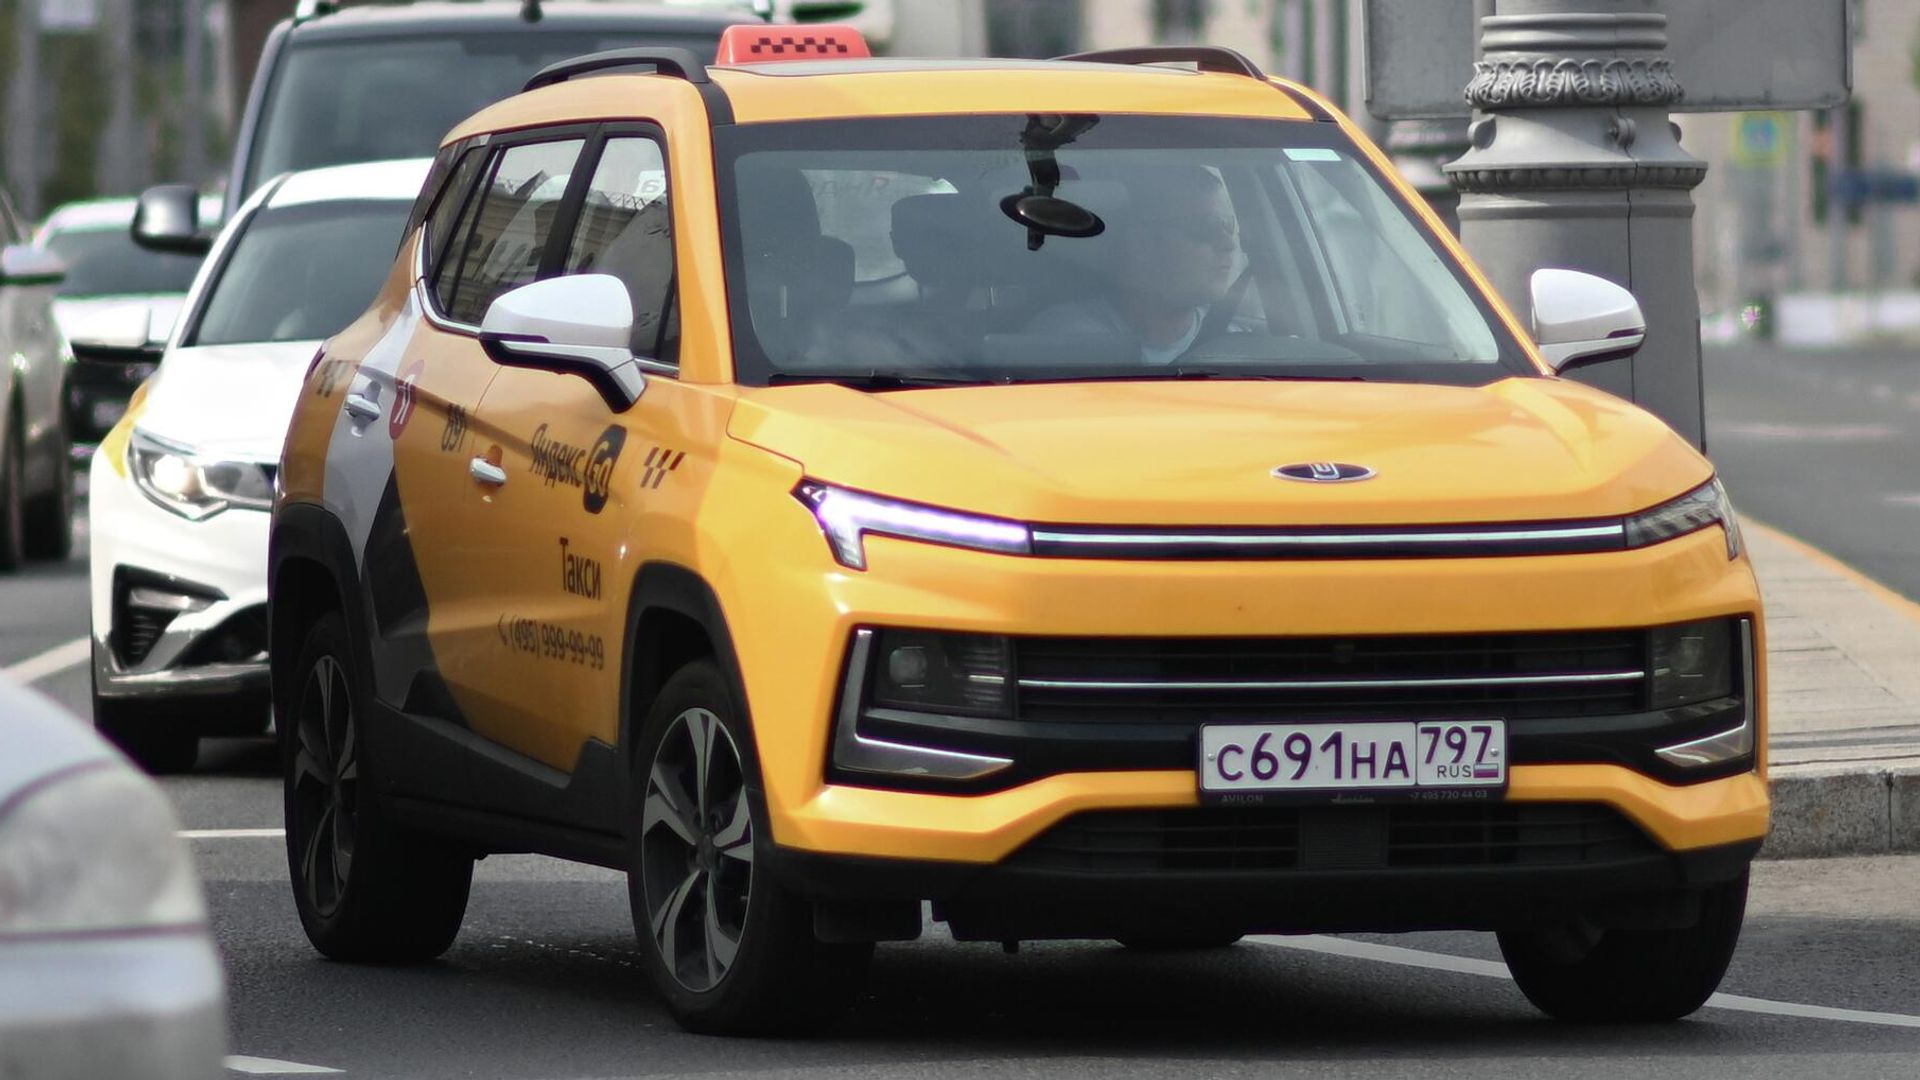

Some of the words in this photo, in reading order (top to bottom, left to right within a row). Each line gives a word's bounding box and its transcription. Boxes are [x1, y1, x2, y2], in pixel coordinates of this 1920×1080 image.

[529, 423, 586, 488] Яндекс
[560, 537, 601, 600] Такси
[509, 614, 541, 660] (495)
[541, 623, 605, 671] 999-99-99
[1420, 725, 1493, 764] 797
[1437, 764, 1472, 778] RUS
[1220, 794, 1264, 804] AVILON
